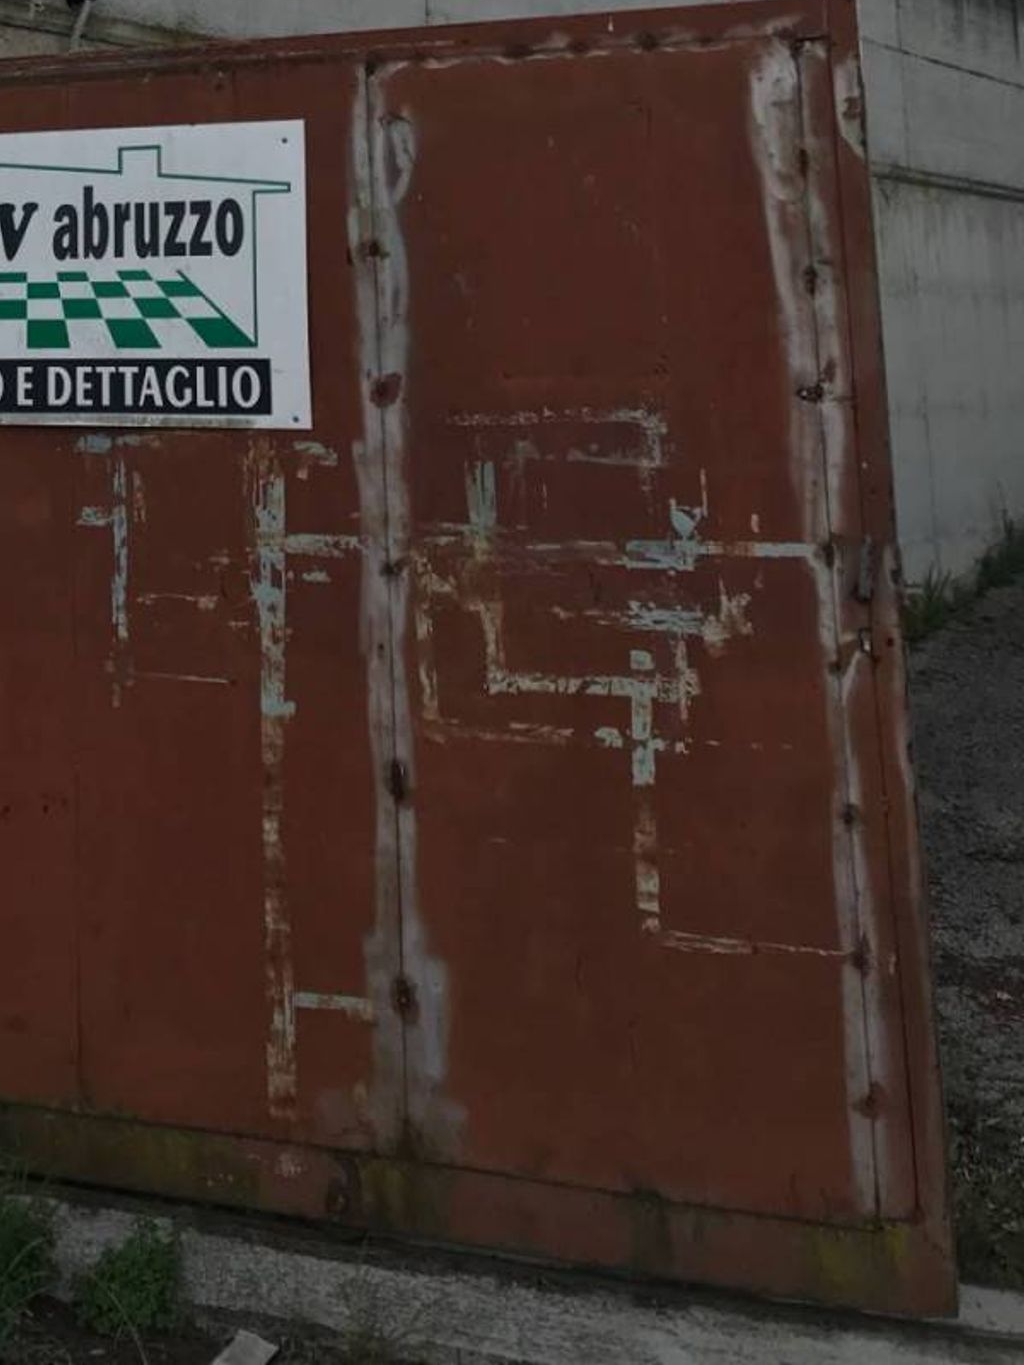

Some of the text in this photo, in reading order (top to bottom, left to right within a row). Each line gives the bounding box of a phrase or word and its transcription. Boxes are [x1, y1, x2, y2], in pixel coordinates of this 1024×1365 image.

[53, 185, 244, 260] abruzzo
[16, 366, 34, 407] E
[47, 365, 262, 409] DETTAGLIO
